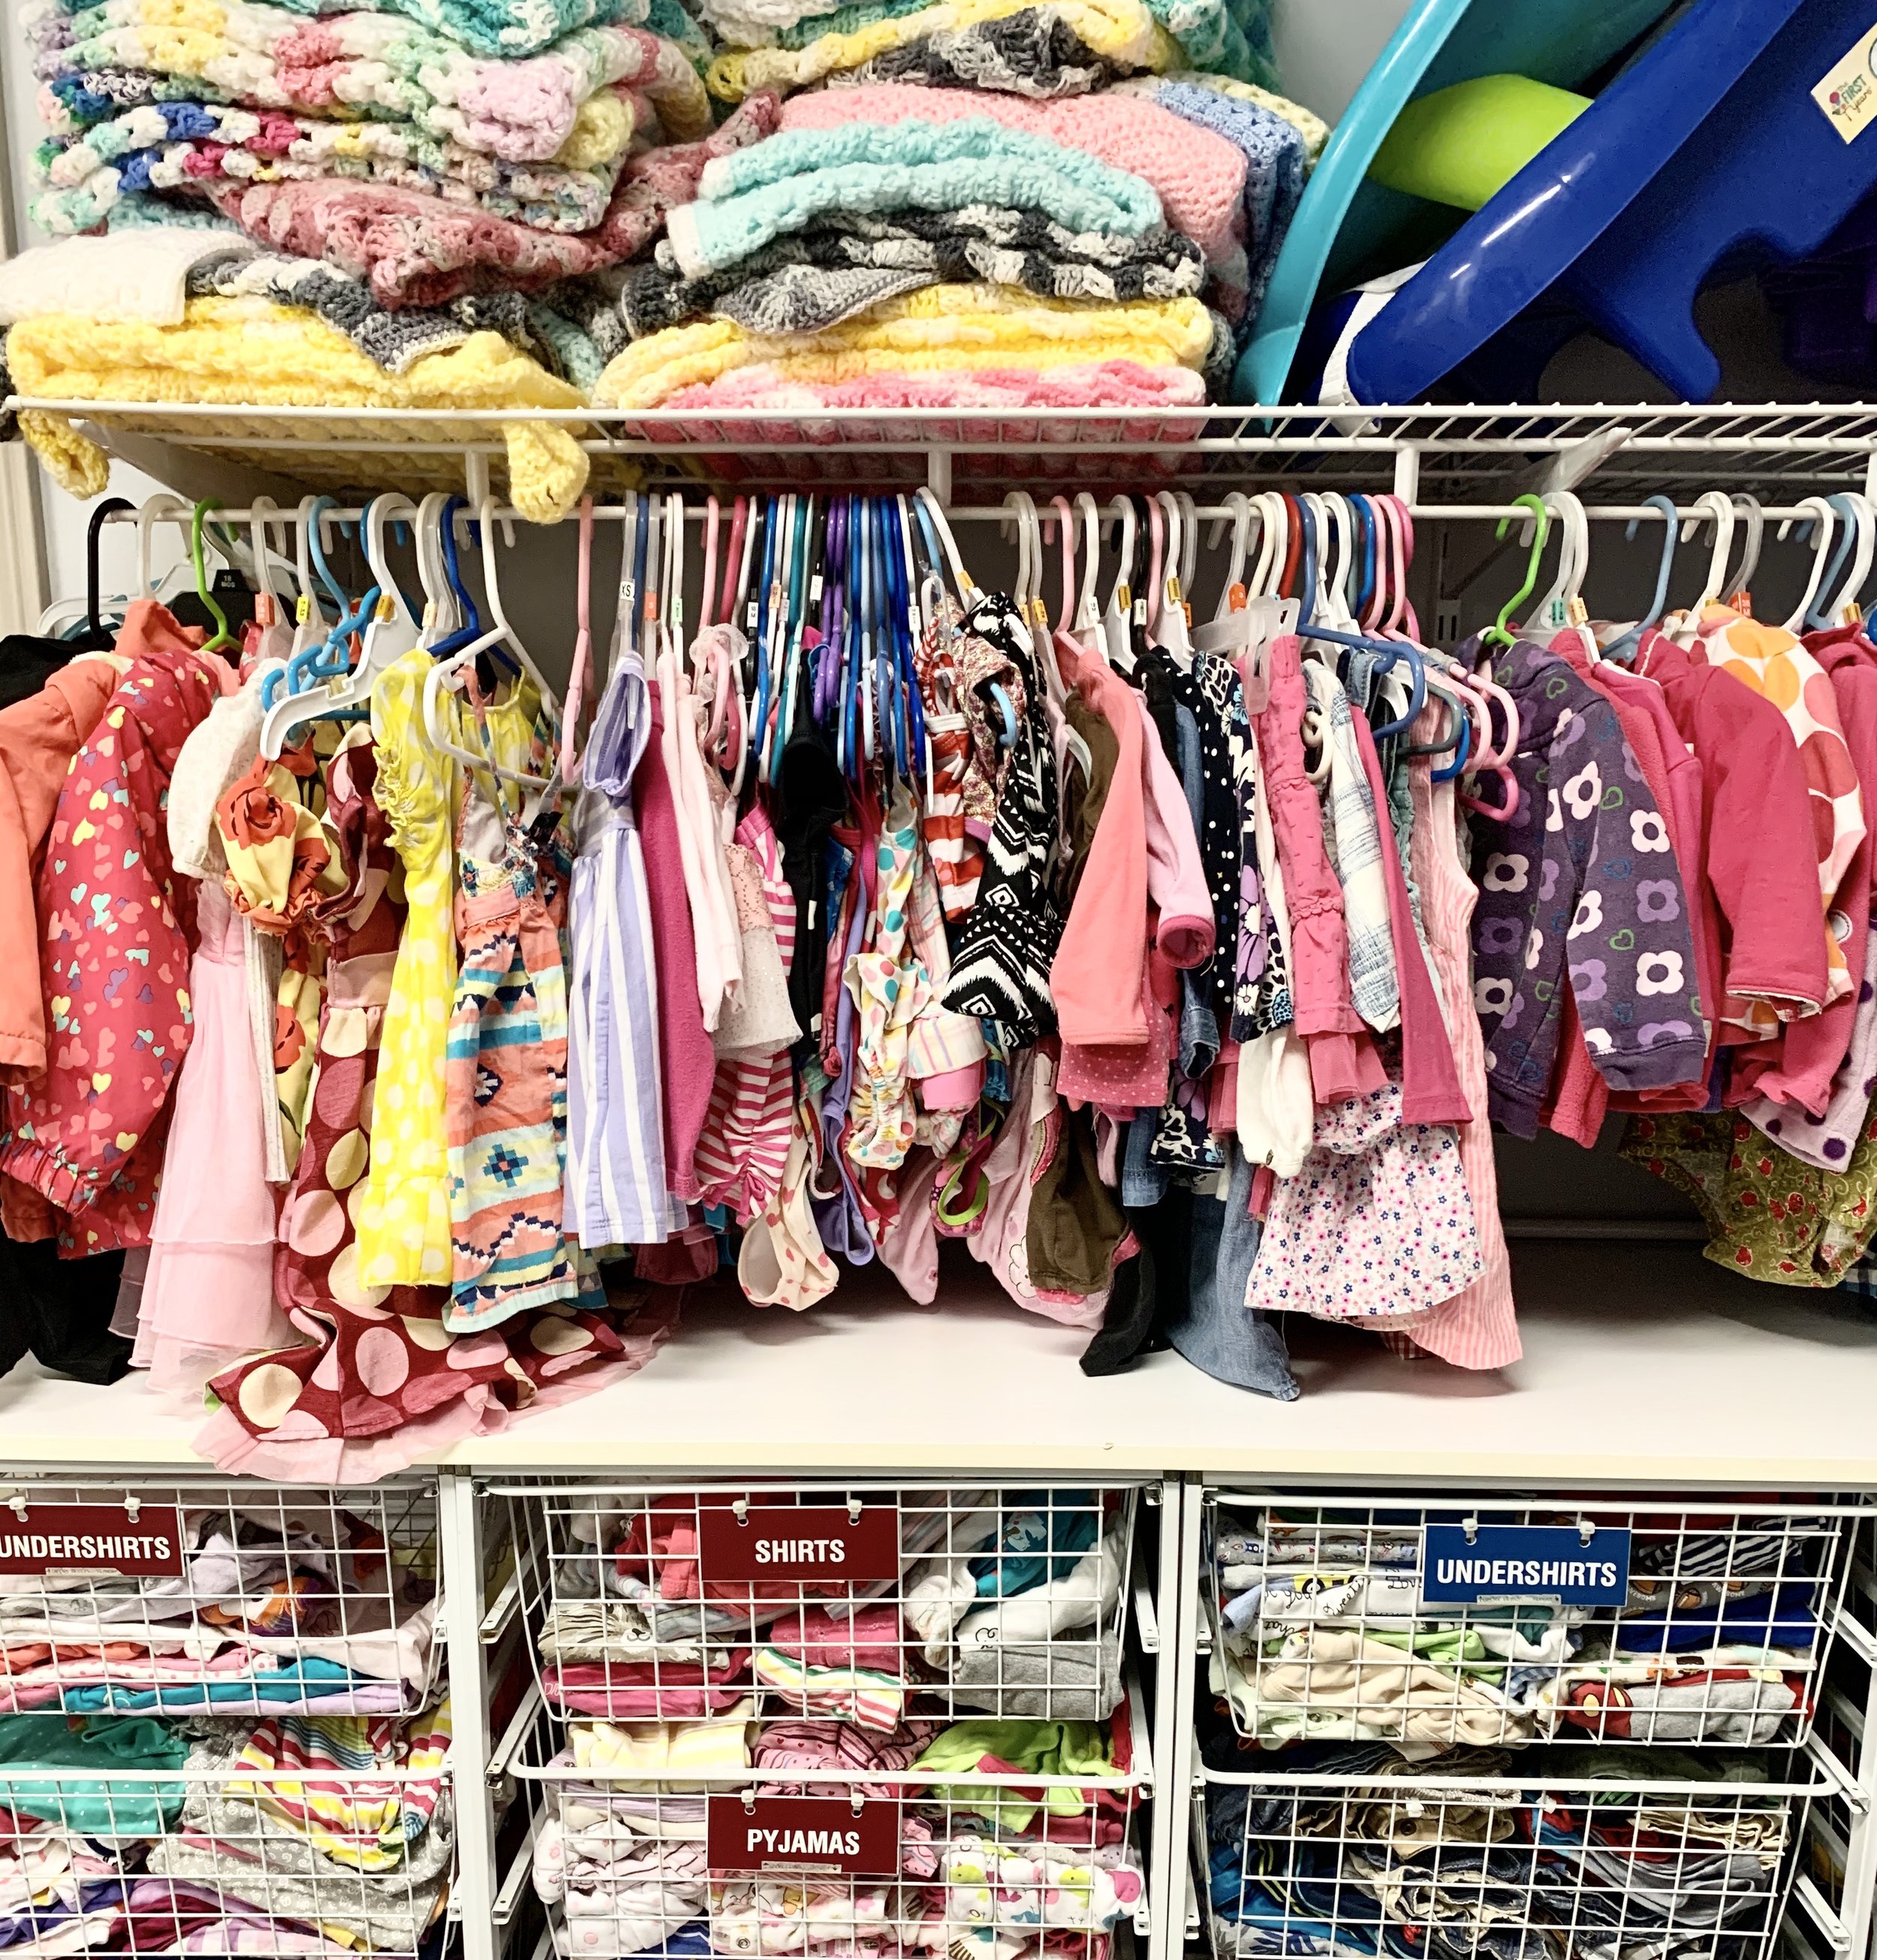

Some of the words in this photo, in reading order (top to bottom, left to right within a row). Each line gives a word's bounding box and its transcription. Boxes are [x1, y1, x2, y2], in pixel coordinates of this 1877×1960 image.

[1841, 74, 1867, 104] FIRST
[621, 583, 632, 598] XS
[0, 1535, 170, 1560] UNDERSHIRTS
[755, 1539, 845, 1563] SHIRTS
[1437, 1558, 1617, 1588] UNDERSHIRTS
[746, 1828, 860, 1856] PYJAMAS
